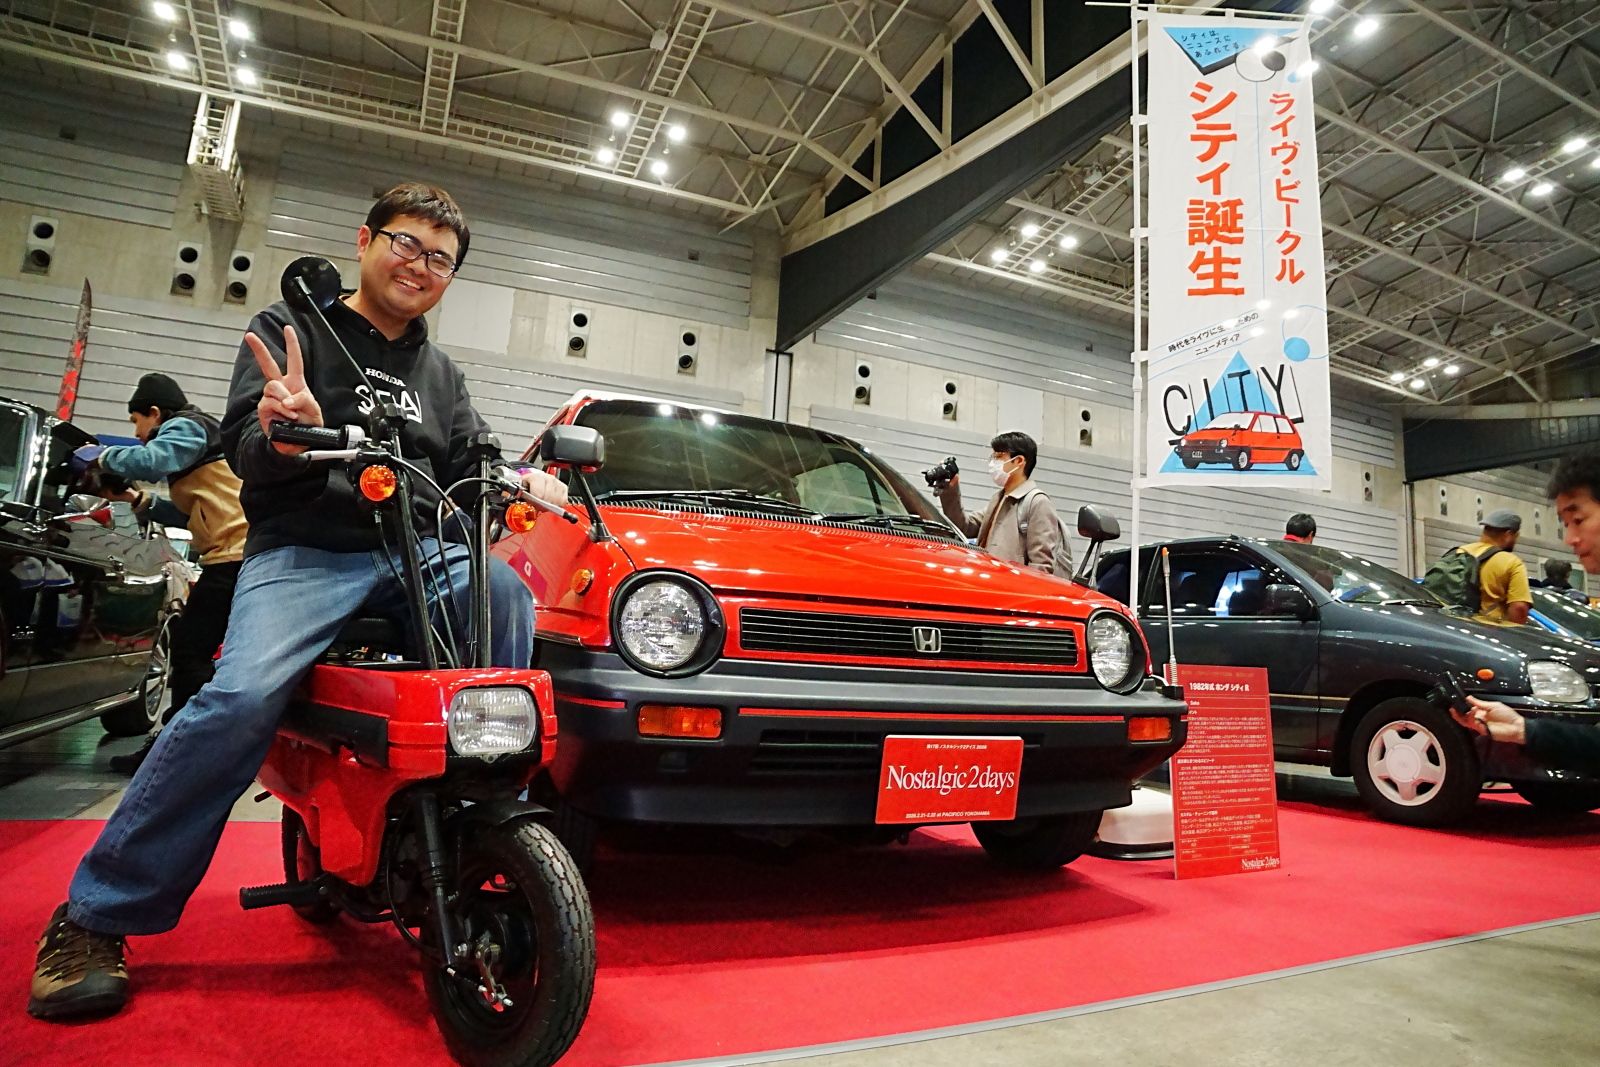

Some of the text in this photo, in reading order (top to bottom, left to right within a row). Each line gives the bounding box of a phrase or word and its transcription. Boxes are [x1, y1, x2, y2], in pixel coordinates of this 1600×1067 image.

[1187, 35, 1231, 50] ニュースに
[1187, 81, 1245, 296] シティ誕生
[1269, 93, 1305, 284] ライヴ・ビークル
[1195, 333, 1240, 356] ニューメディア
[365, 368, 406, 387] HONDA
[1163, 364, 1304, 446] CITY
[886, 765, 1015, 795] Nostalgic 2days
